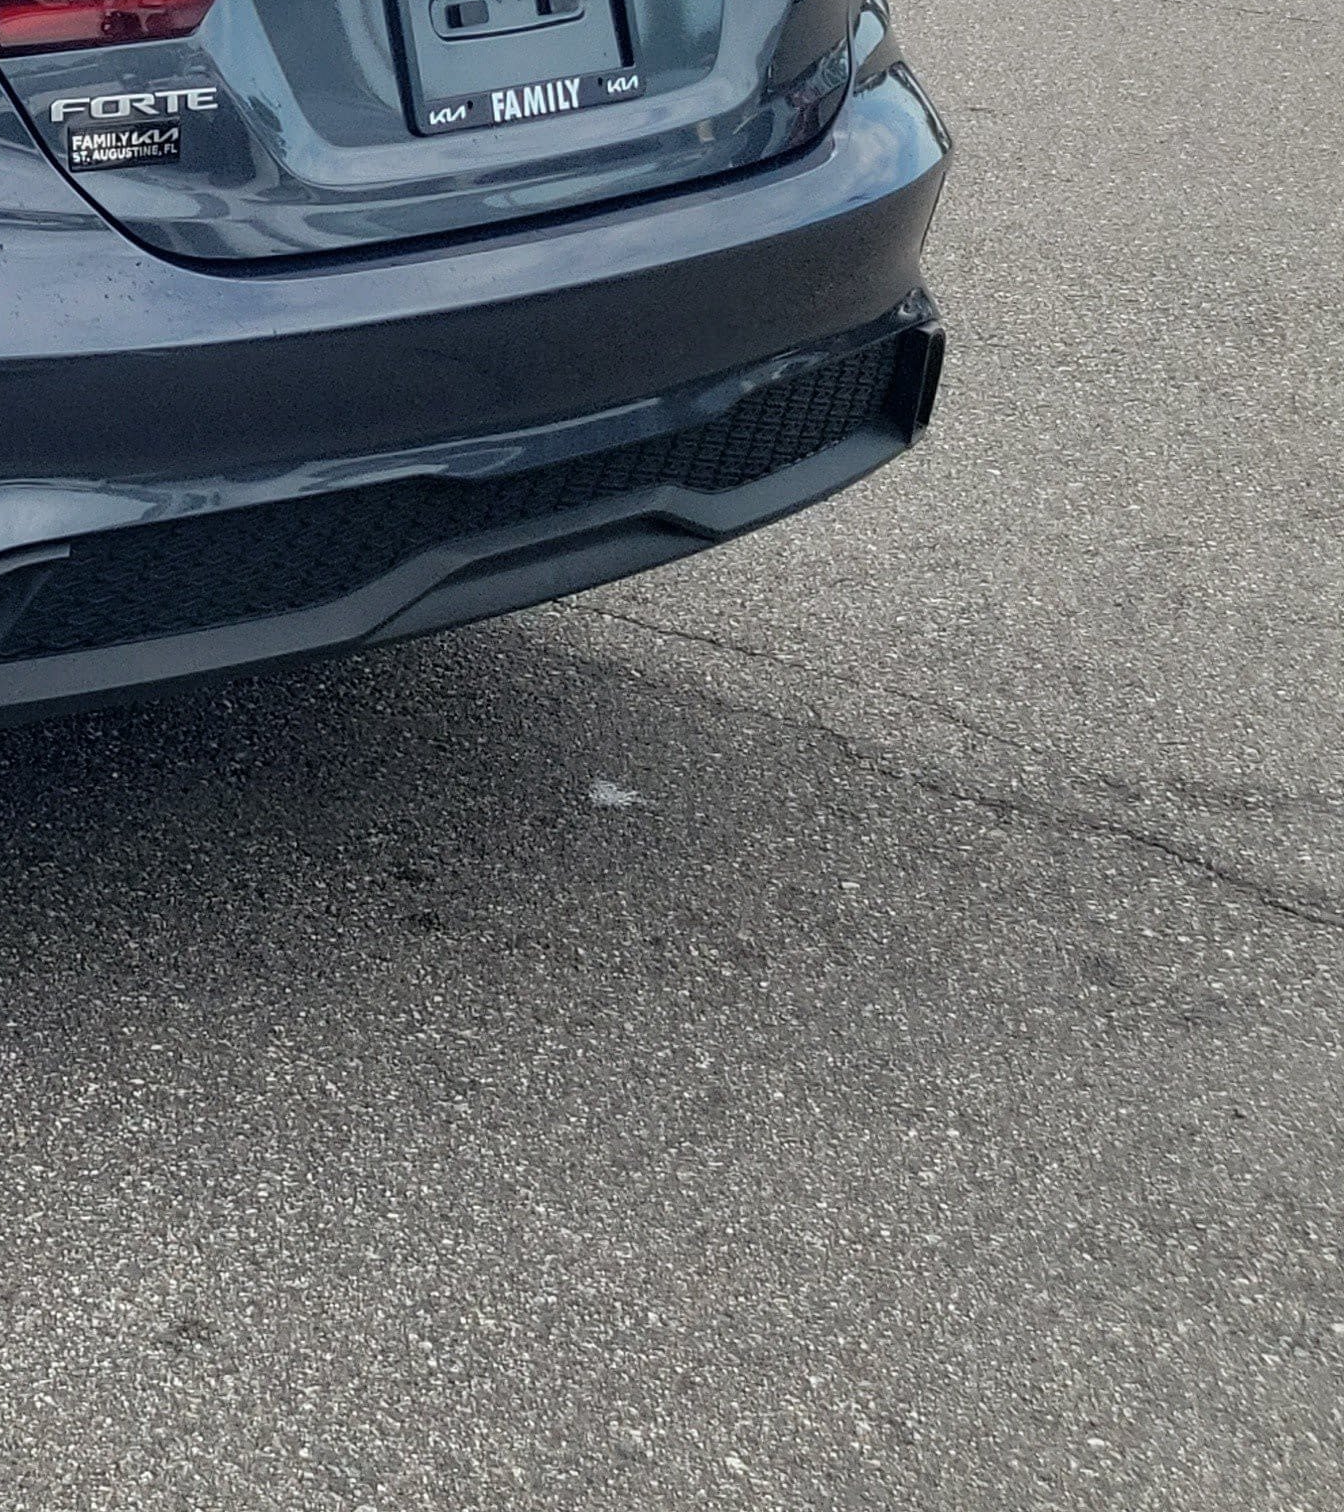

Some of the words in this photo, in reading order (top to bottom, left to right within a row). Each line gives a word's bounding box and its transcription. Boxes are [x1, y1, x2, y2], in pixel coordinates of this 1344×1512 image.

[50, 87, 218, 123] FORTE
[429, 105, 467, 125] KIA
[491, 78, 580, 122] FAMILY
[607, 74, 639, 94] KIA
[72, 131, 130, 151] FAMILY
[131, 127, 179, 145] KIA
[72, 150, 91, 164] ST.
[92, 144, 162, 161] AUGUSTINE,
[163, 143, 178, 155] FL
